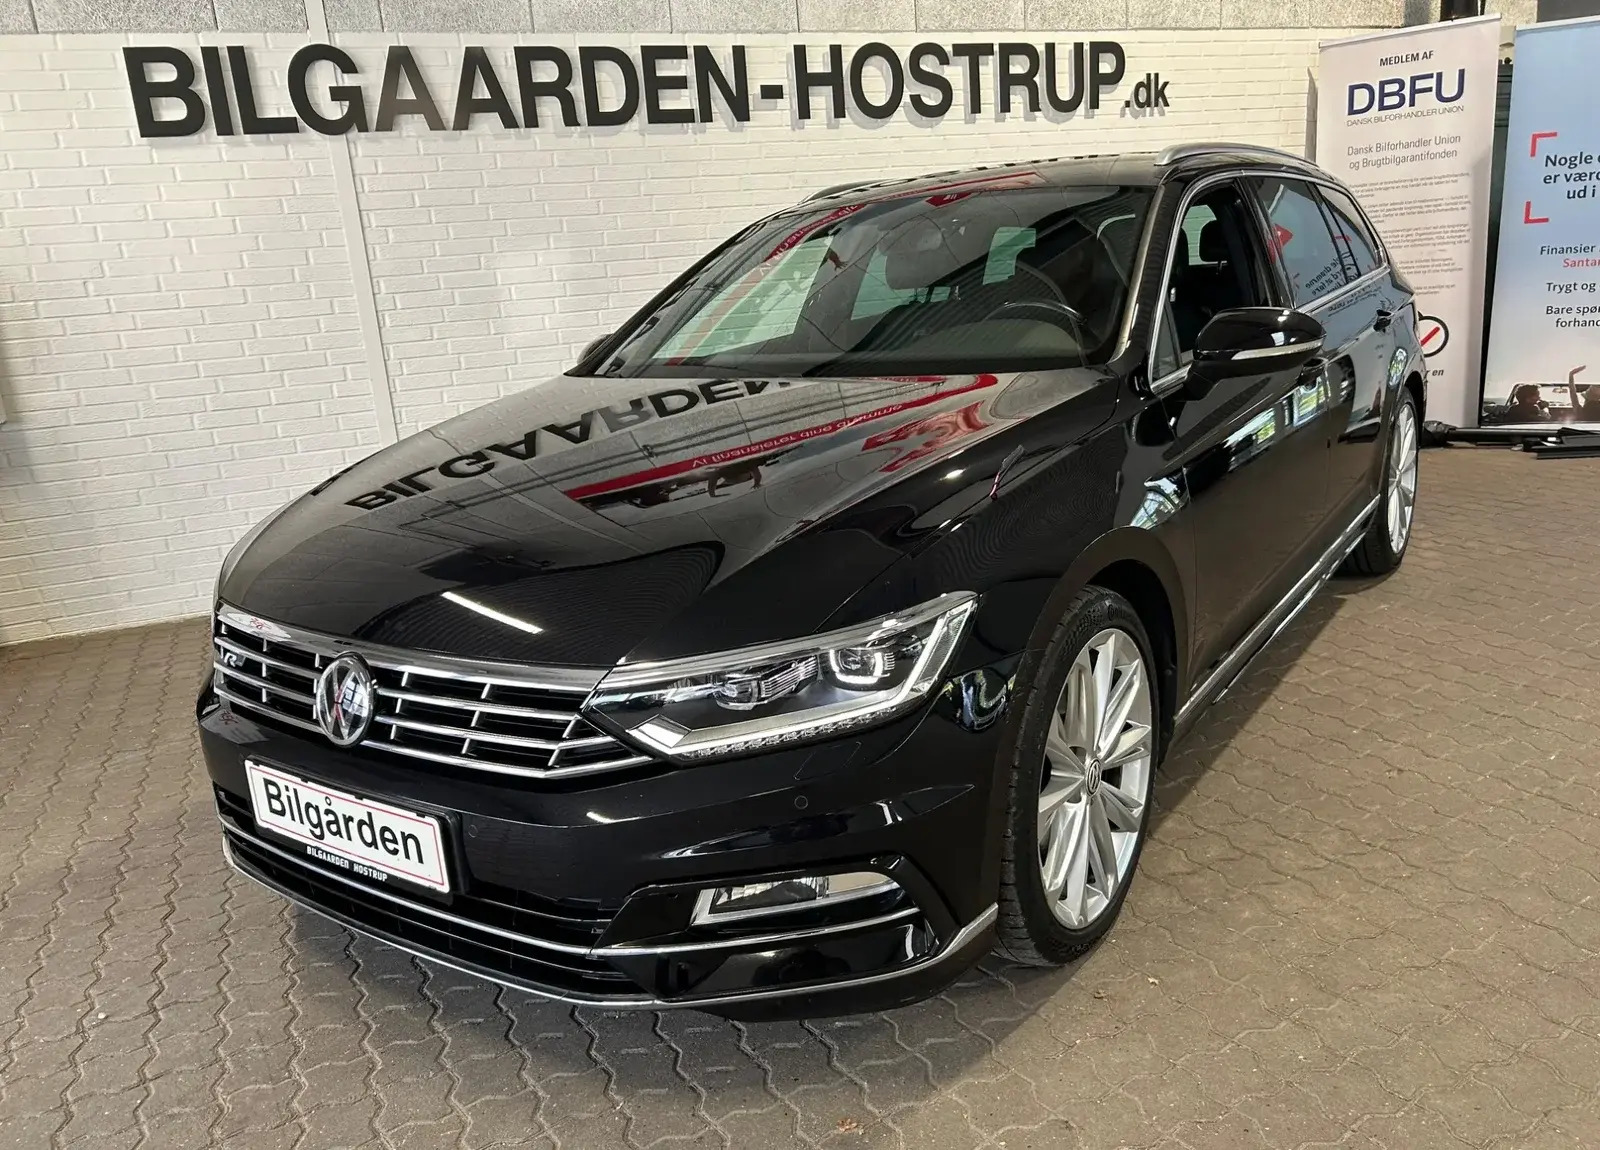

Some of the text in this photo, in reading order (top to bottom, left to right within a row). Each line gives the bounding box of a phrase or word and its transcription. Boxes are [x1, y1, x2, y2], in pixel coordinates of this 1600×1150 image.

[1379, 50, 1434, 67] MEDLEM AF
[1347, 68, 1466, 116] DBFU
[1346, 105, 1465, 127] DANSK BILFORHANDLER UNION
[1347, 135, 1461, 156] Dansk Bilforhandler Union
[1349, 149, 1458, 170] og Brugtbilgarantifonden
[1544, 151, 1594, 169] Nogle
[1543, 173, 1560, 184] er
[1566, 185, 1596, 199] ud i
[1540, 244, 1597, 255] Finansier
[1546, 281, 1578, 294] Trygt
[1581, 282, 1597, 293] og
[1546, 305, 1573, 315] Bare
[1431, 369, 1445, 377] en
[262, 777, 425, 865] Bilgården
[306, 846, 388, 882] BILGAARDEN HOSTRUP
